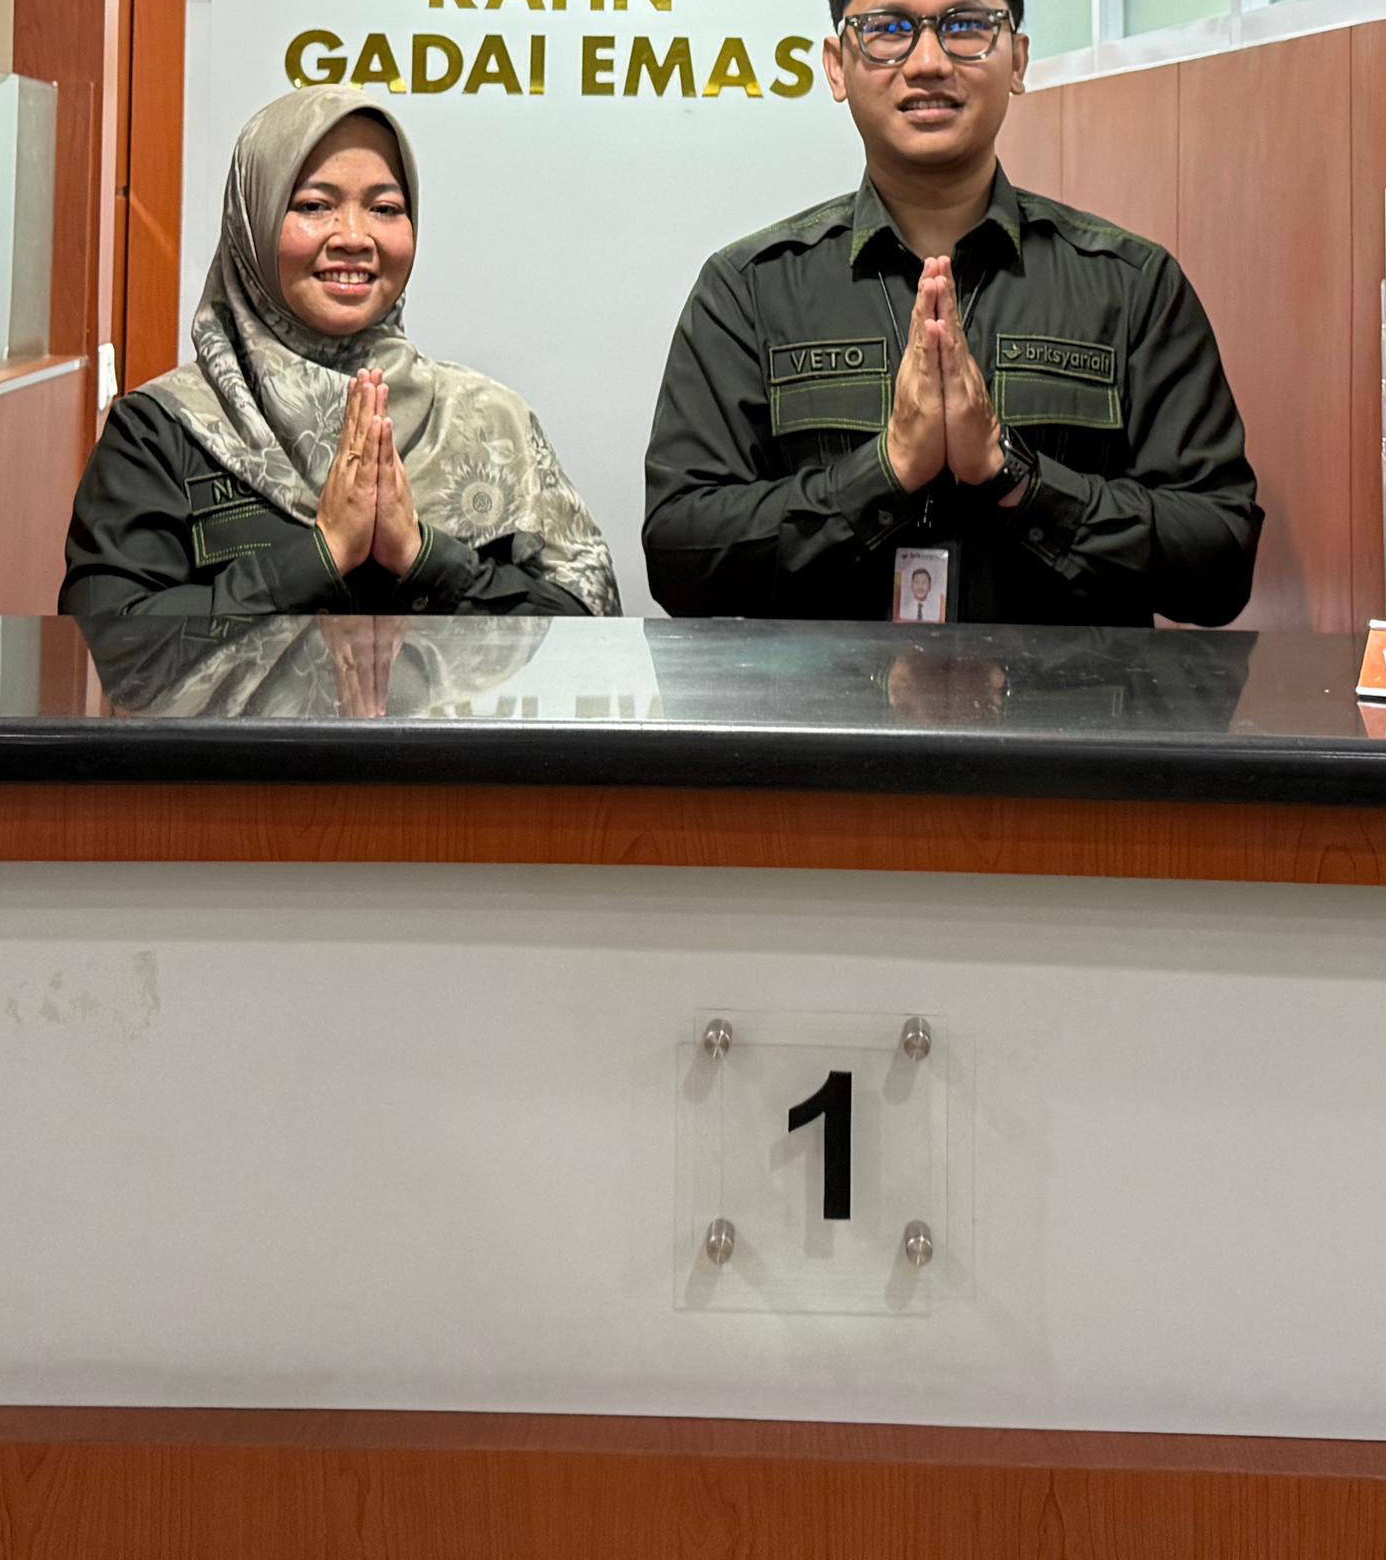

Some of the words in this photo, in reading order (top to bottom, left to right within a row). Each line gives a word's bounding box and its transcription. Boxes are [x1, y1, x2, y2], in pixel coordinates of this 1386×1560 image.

[284, 29, 546, 95] GADAI
[581, 34, 815, 99] EMAS
[790, 345, 864, 374] VETO
[1024, 342, 1111, 375] brksyariah
[788, 1070, 852, 1220] 1
